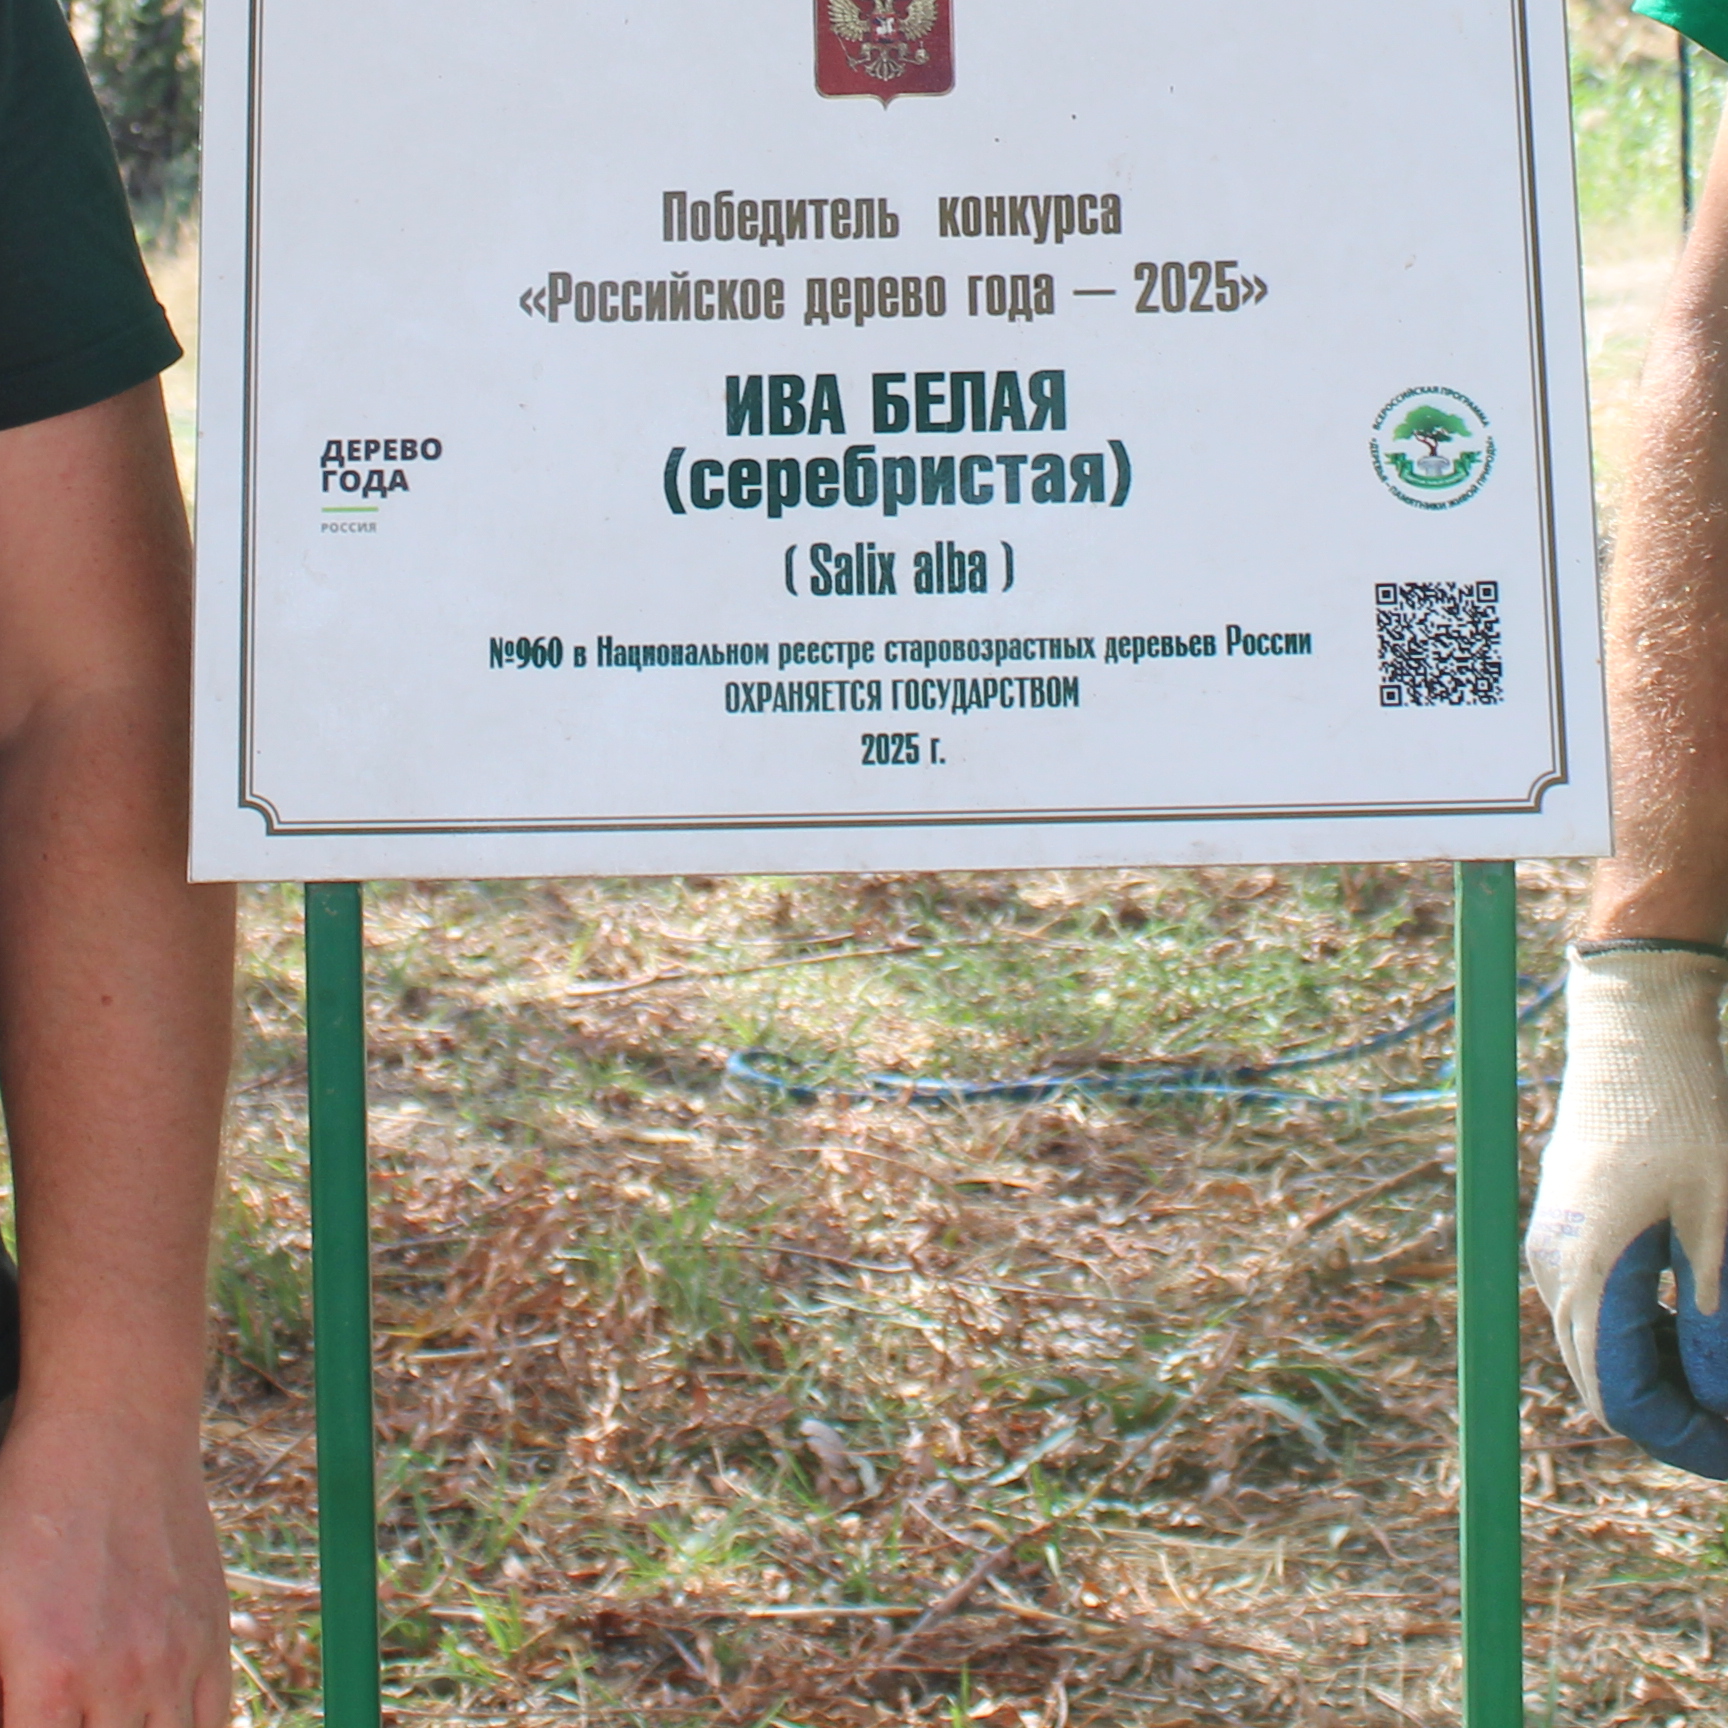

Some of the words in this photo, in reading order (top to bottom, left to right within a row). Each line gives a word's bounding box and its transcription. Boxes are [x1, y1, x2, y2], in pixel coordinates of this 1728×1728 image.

[662, 189, 900, 248] Победитель
[938, 192, 1123, 245] конкурса
[519, 270, 785, 324] «Российское
[803, 274, 947, 327] дерево
[967, 272, 1056, 323] года
[1133, 259, 1269, 314] 2025»
[724, 372, 847, 437] ИВА
[871, 368, 1067, 435] БЕЛАЯ
[320, 438, 443, 468] ДЕРЕВО
[322, 469, 410, 499] ГОДА
[663, 438, 1132, 520] (серебристая)
[321, 522, 376, 533] РОССИЯ
[809, 541, 898, 597] Salix
[912, 540, 988, 595] alba
[489, 635, 564, 670] №960
[573, 645, 588, 669] в
[596, 634, 770, 673] Национальном
[778, 640, 875, 672] реестре
[884, 636, 1097, 669] старовозрастных
[1103, 633, 1218, 665] деревьев
[1225, 623, 1313, 657] России
[724, 678, 883, 714] ОХРАНЯЕТСЯ
[891, 675, 1080, 716] ГОСУДАРСТВОМ
[860, 731, 921, 766] 2025
[929, 737, 947, 765] г.
